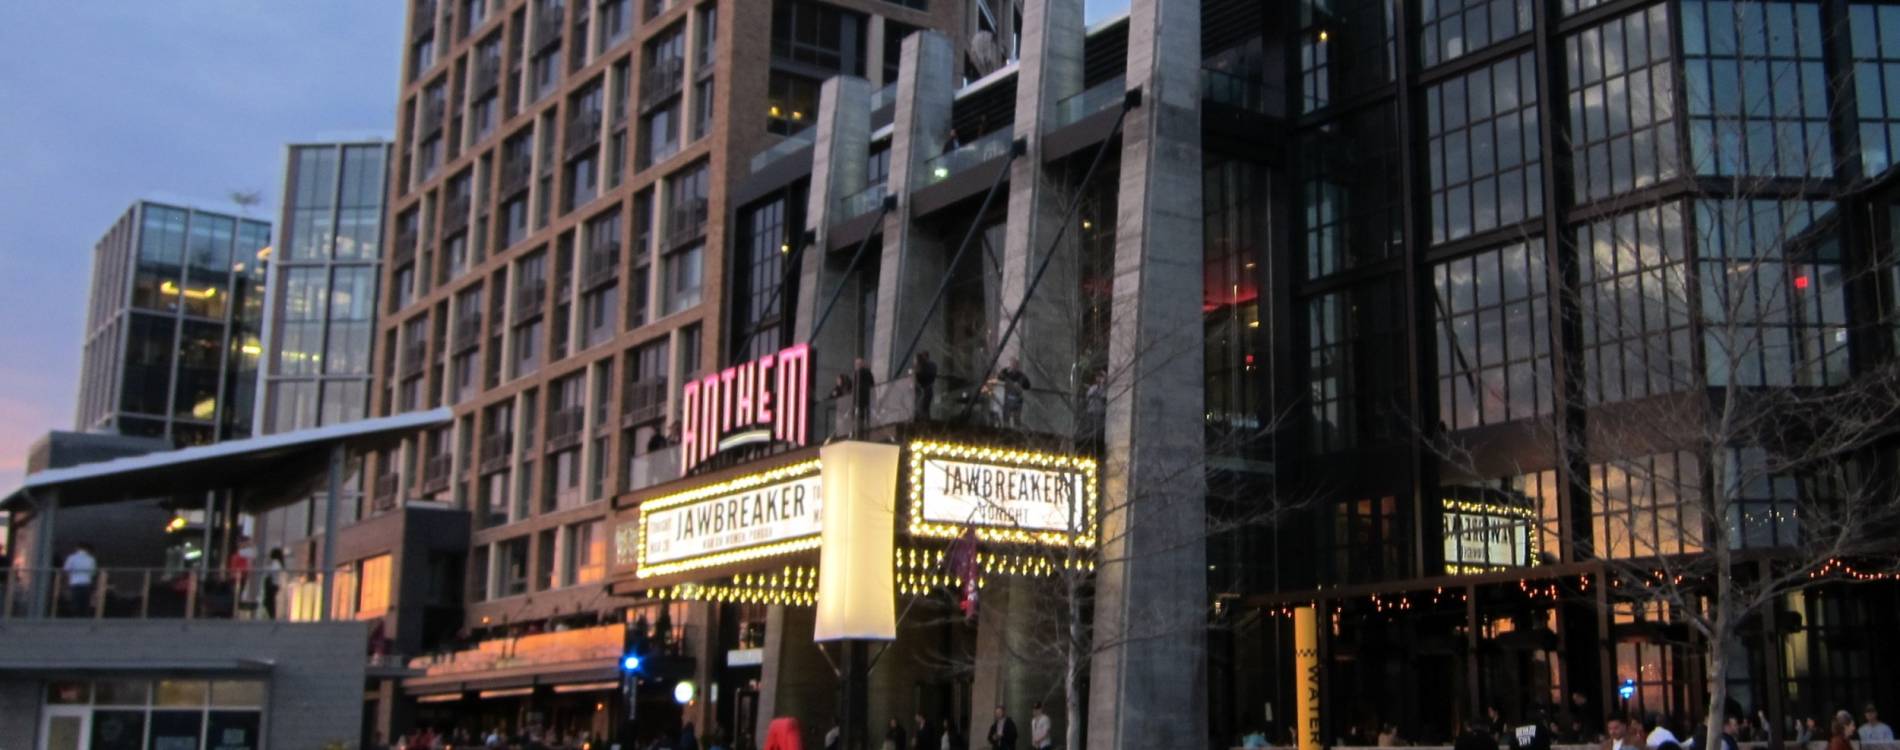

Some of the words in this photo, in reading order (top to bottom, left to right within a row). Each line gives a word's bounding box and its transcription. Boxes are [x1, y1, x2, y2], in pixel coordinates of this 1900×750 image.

[680, 343, 810, 477] ANTHEM
[675, 484, 806, 542] JAWBREAKER
[944, 464, 1064, 504] JAWBREAKER
[1308, 664, 1320, 744] WATER
